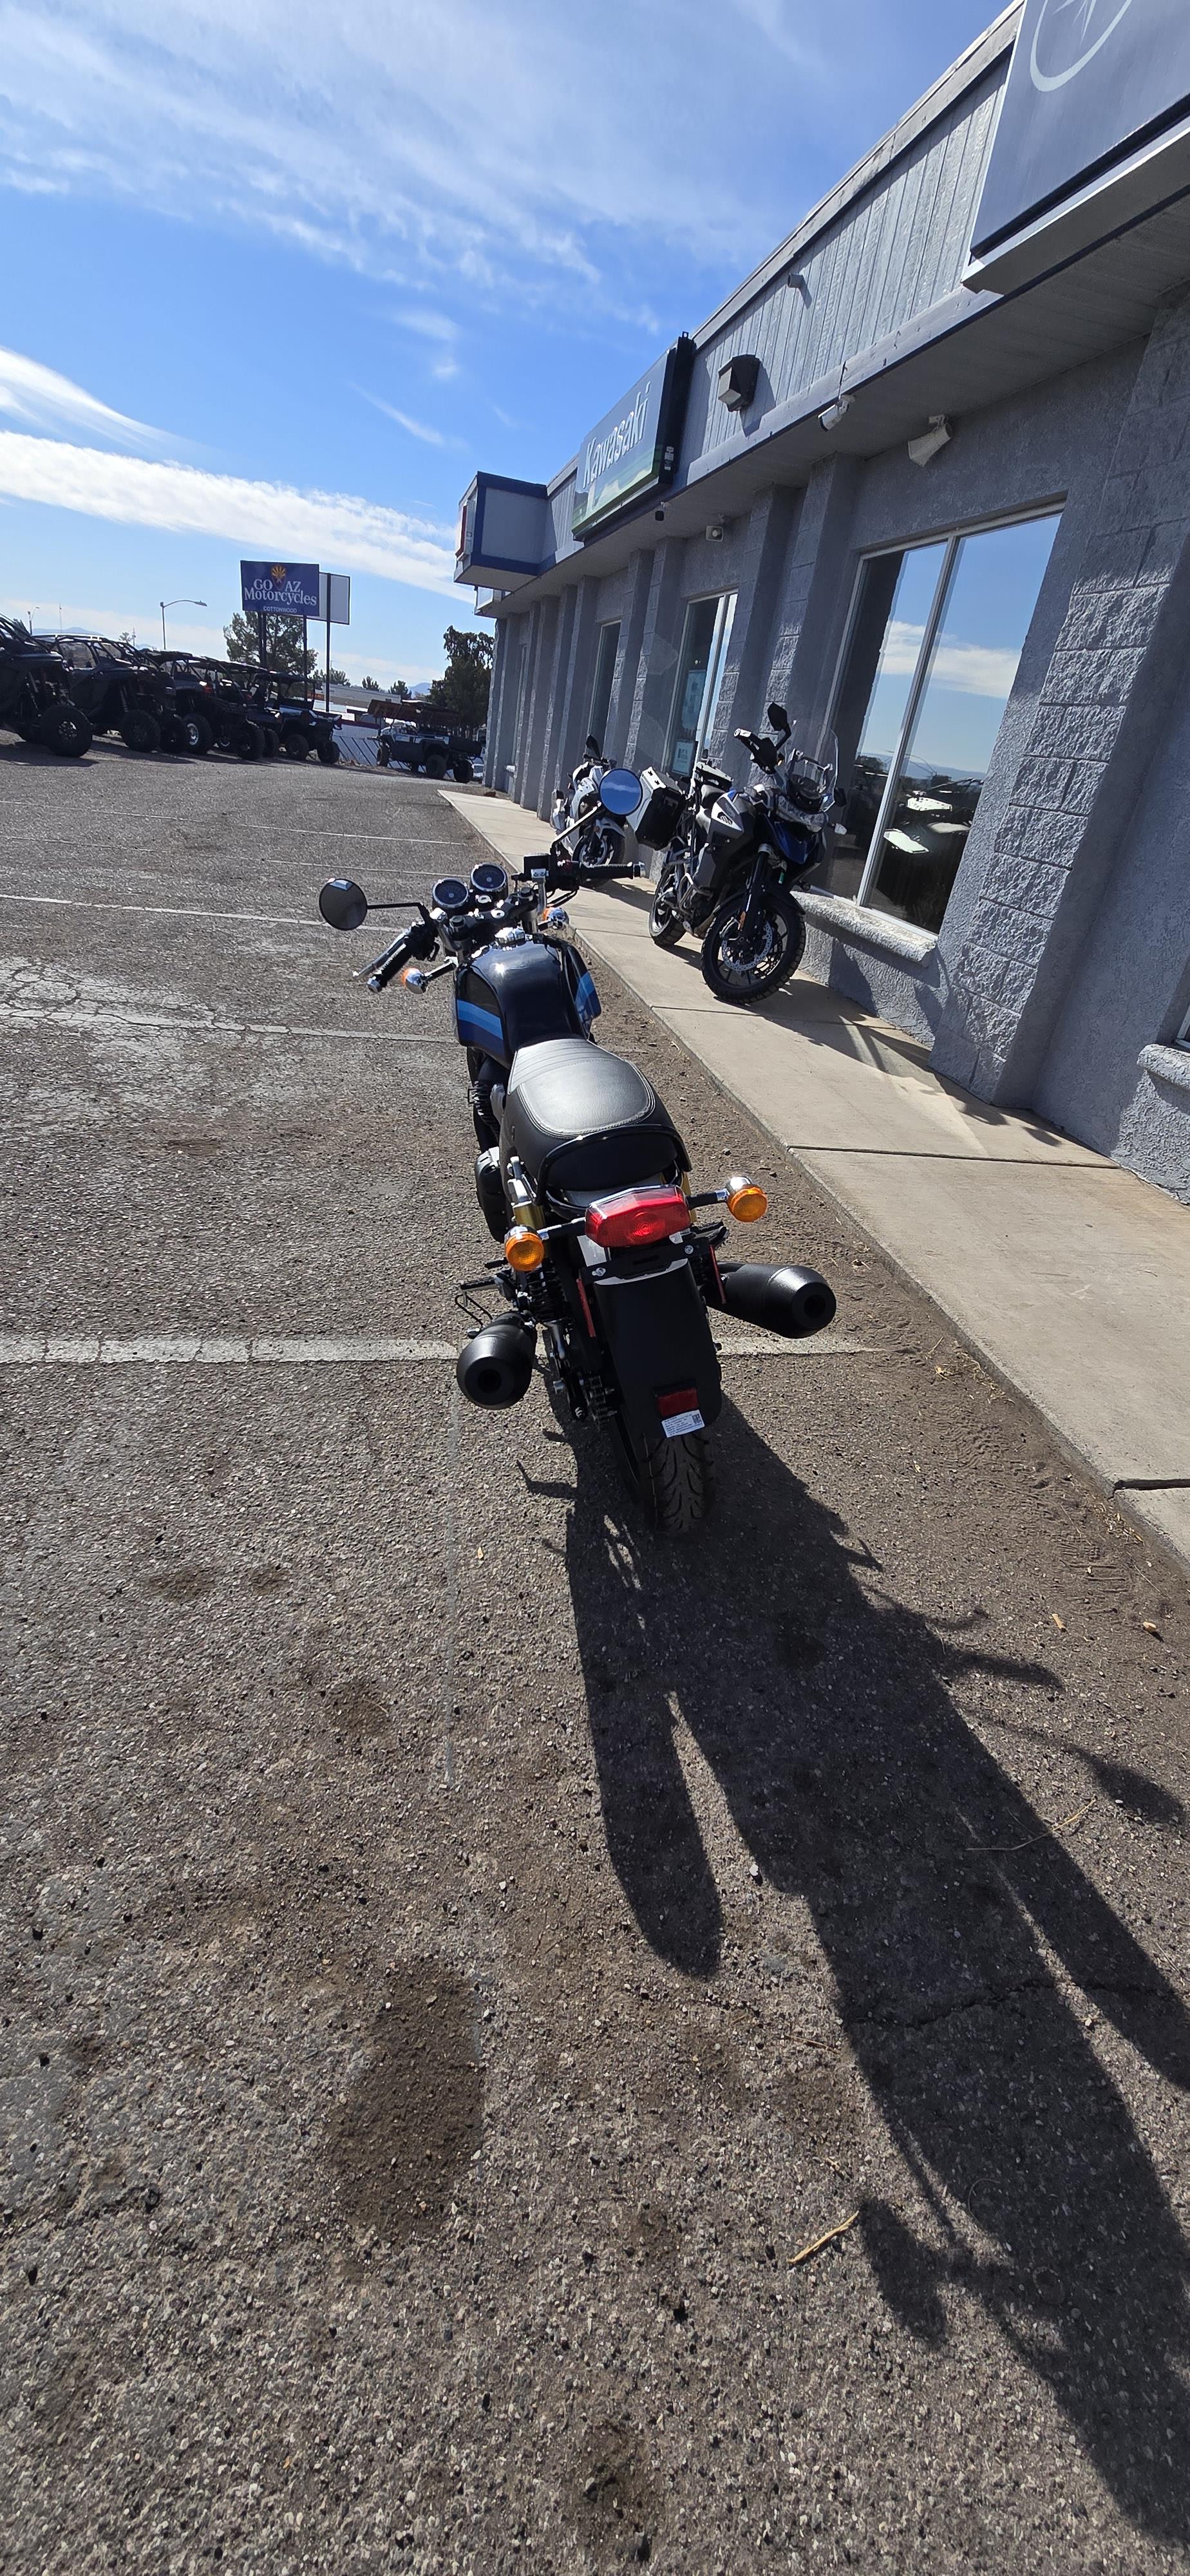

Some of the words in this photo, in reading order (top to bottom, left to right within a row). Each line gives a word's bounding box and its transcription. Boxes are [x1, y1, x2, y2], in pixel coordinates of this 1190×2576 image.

[583, 381, 651, 489] Kawasaki
[253, 578, 273, 591] GO
[285, 581, 302, 592] AZ
[244, 587, 317, 606] Motorcycles
